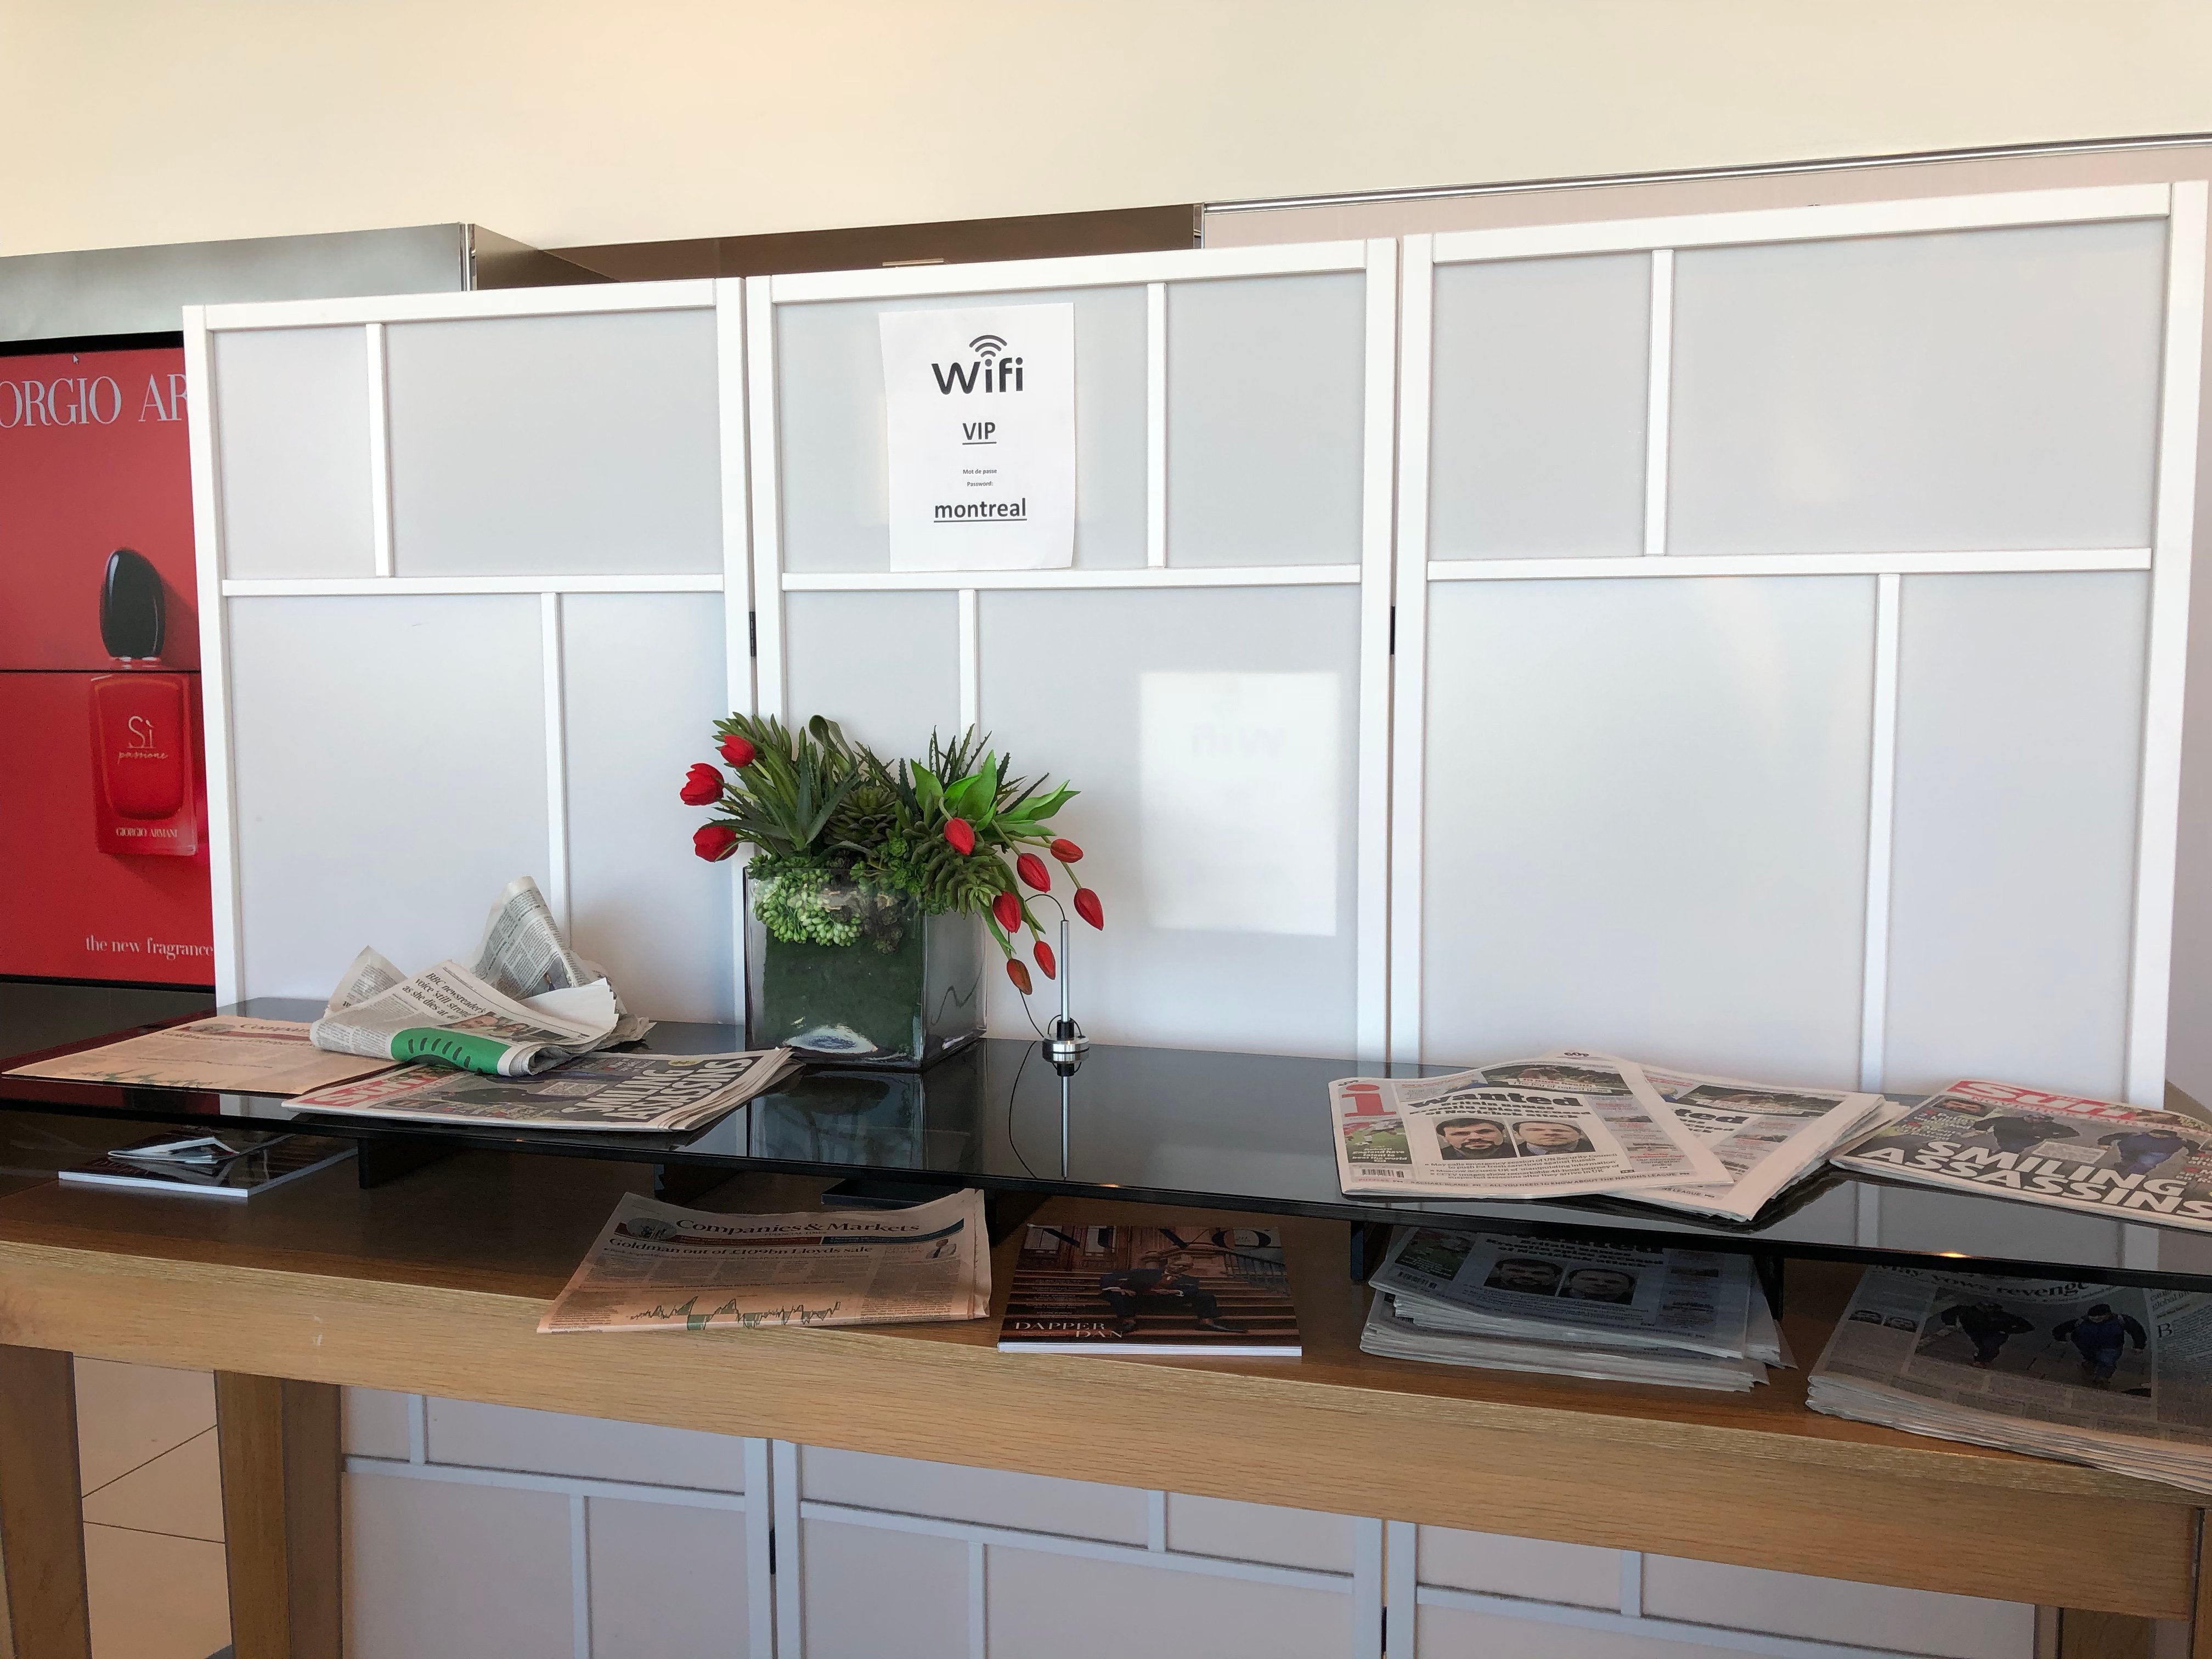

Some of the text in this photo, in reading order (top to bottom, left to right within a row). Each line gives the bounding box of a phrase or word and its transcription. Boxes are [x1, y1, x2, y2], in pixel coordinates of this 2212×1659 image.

[931, 357, 1023, 395] Wifi
[0, 376, 122, 428] ORGIO
[963, 422, 996, 441] VIP
[935, 498, 1026, 518] montreal
[116, 827, 178, 838] GIORGIO ARMANI
[86, 935, 214, 960] the new fragrance
[402, 985, 414, 994] as
[410, 991, 425, 1001] she
[422, 997, 440, 1011] dies
[415, 978, 435, 993] voice
[425, 973, 486, 1013] BBC newsreader's
[313, 1078, 429, 1105] Sun
[561, 1069, 695, 1113] SMILING
[602, 1058, 753, 1120] ASSASSINS
[1342, 1084, 1397, 1118] i
[1955, 1082, 2129, 1117] Sun
[1858, 1147, 2212, 1218] ASSASSINS
[1917, 1141, 2188, 1197] SMILING
[676, 1220, 919, 1235] Companies & Markets
[609, 1238, 680, 1253] Goldman
[1075, 1330, 1123, 1338] DAN
